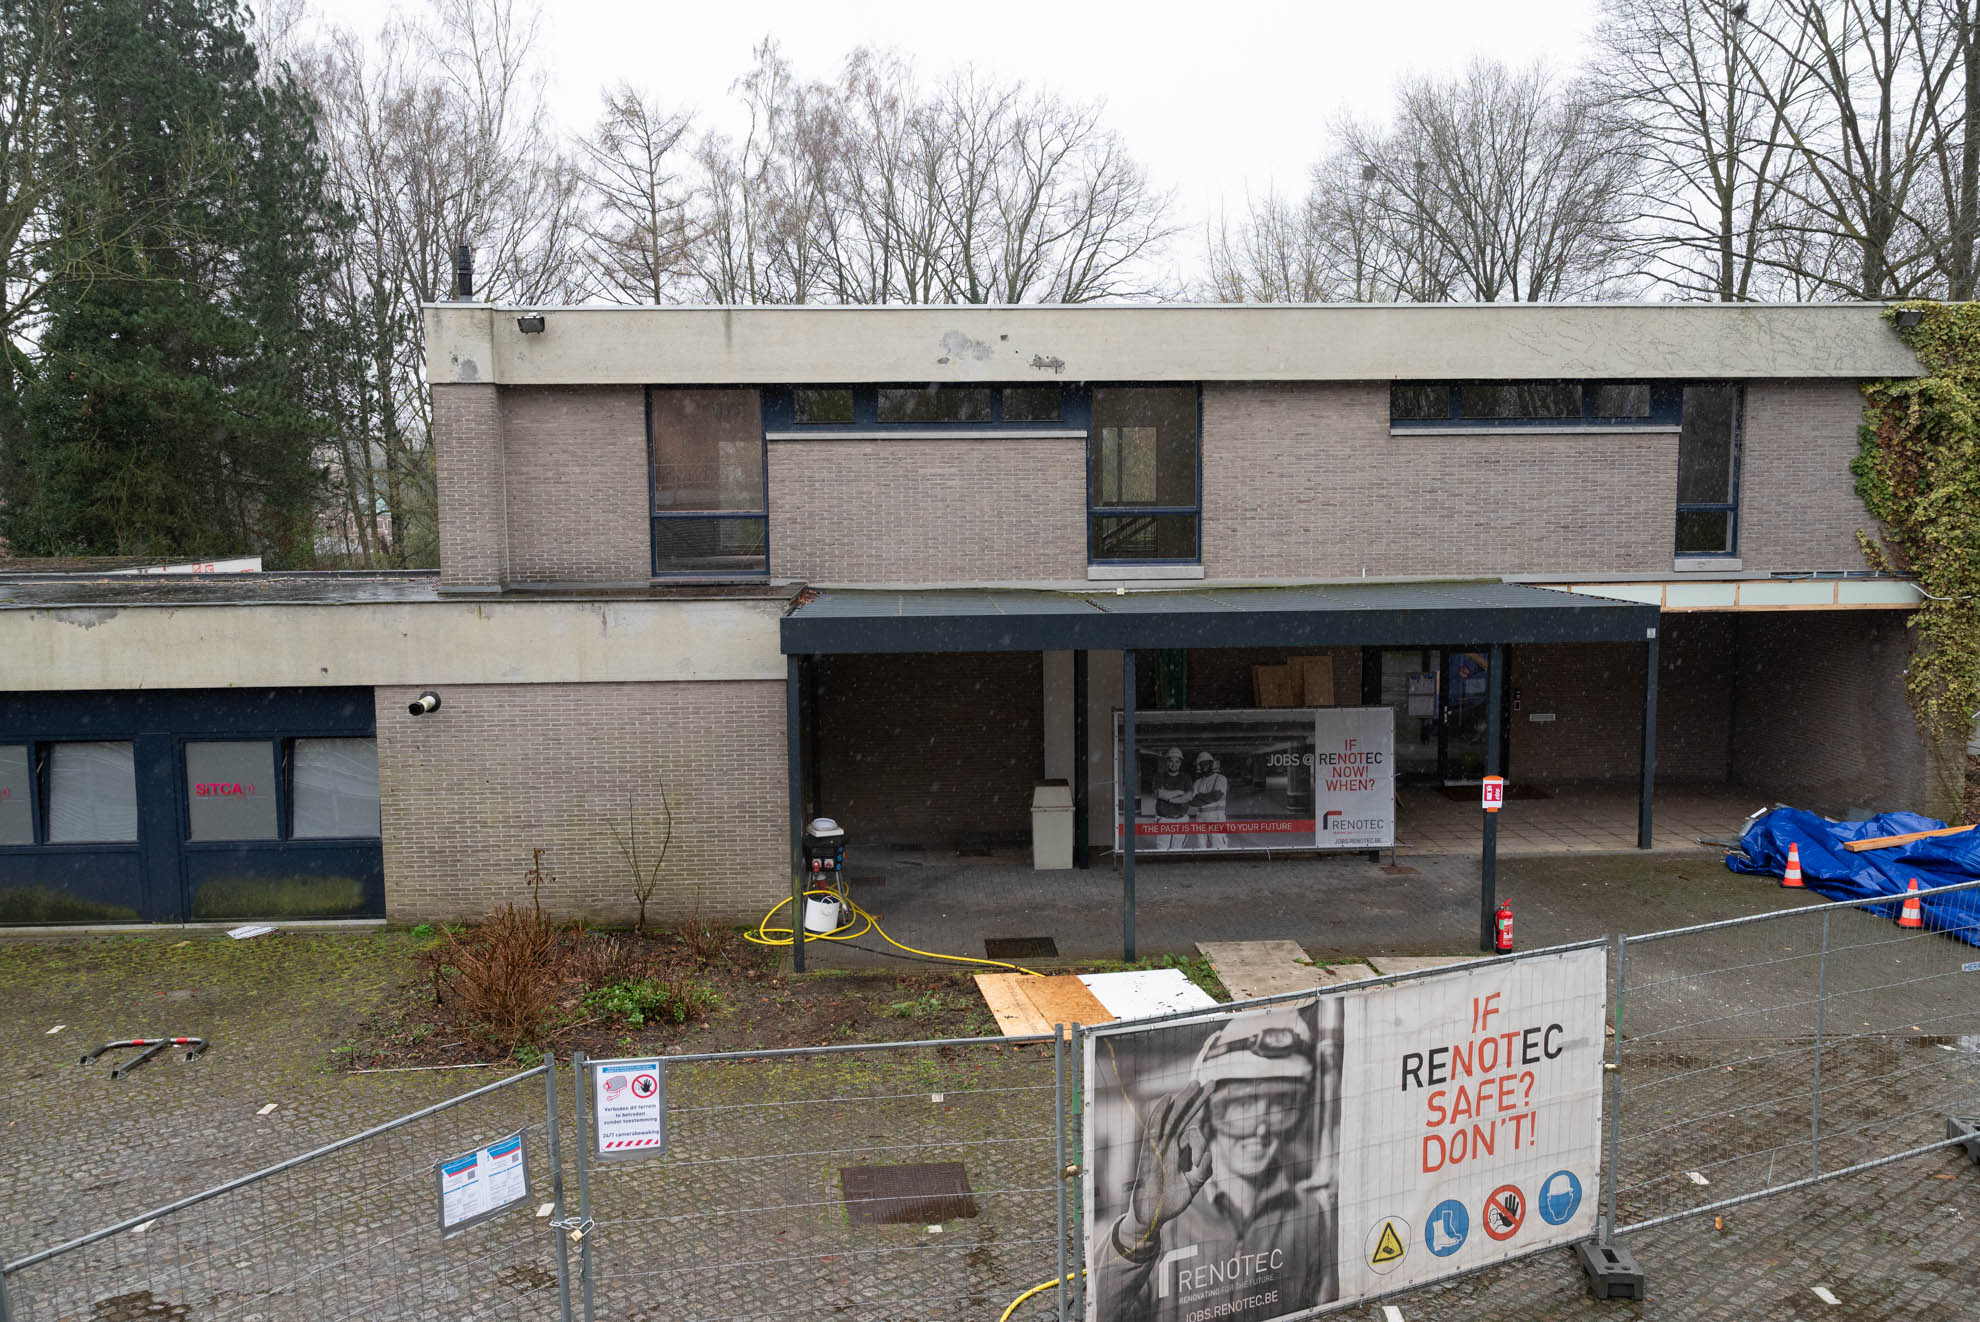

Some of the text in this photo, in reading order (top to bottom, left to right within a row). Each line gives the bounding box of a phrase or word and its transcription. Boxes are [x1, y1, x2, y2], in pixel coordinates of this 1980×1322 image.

[1344, 738, 1357, 751] IF
[1266, 753, 1315, 767] JOBS @
[1319, 751, 1383, 766] RENOTEC
[1332, 766, 1369, 778] NOW!
[1326, 779, 1376, 792] WHEN?
[1143, 822, 1293, 833] THE PAST IS THE KEY TO YOUR FUTURE
[1332, 819, 1384, 831] RENOTEC
[1472, 992, 1501, 1034] IF
[1401, 1023, 1564, 1092] RENOTEC
[1426, 1070, 1535, 1128] SAFE?
[1422, 1110, 1537, 1174] DON'T!
[1178, 1248, 1284, 1293] RENOTEC
[1179, 1288, 1220, 1305] RENOVATING
[1221, 1285, 1234, 1293] FOR
[1249, 1274, 1275, 1285] FUTURE
[1186, 1290, 1279, 1322] JOBS.RENOTEC.BE
